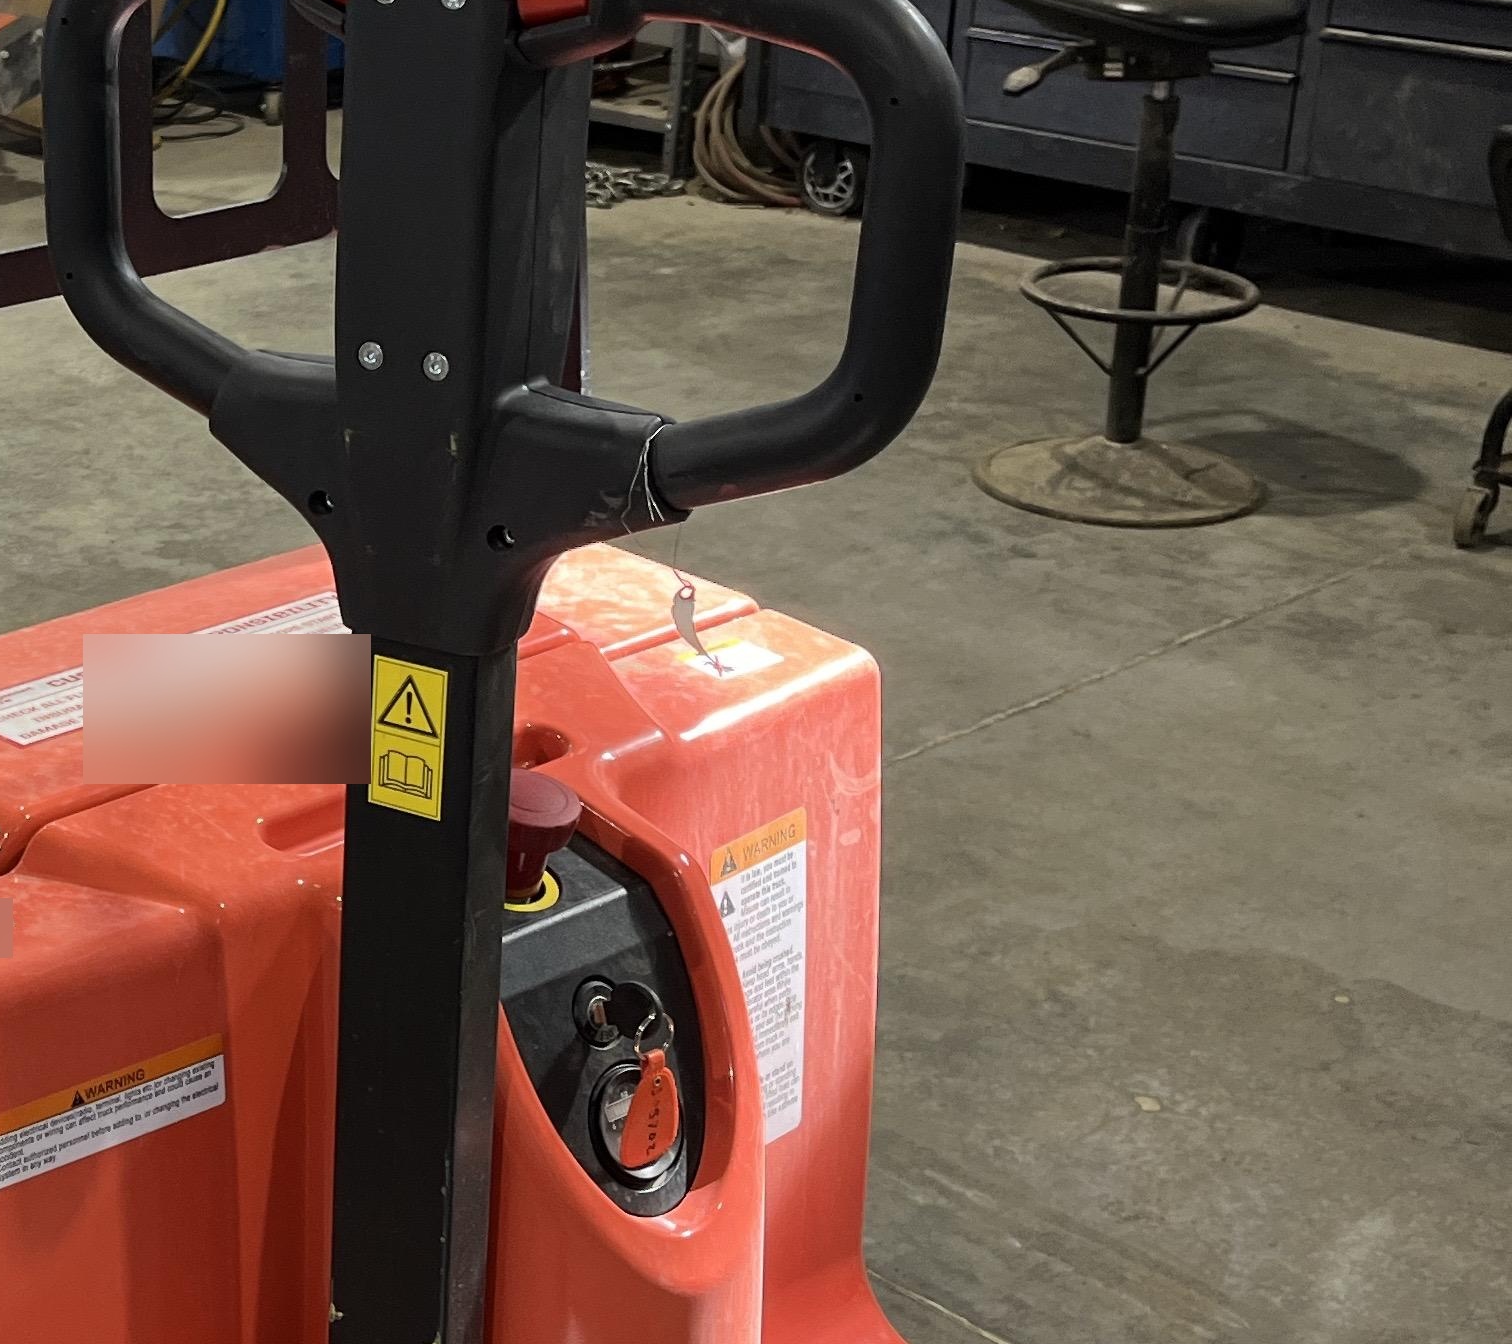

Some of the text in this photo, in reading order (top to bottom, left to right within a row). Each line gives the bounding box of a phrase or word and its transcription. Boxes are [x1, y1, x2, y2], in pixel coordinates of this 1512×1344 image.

[742, 824, 795, 862] WARNING
[85, 1068, 144, 1099] WARNING
[19, 1121, 48, 1139] electrical
[23, 1144, 57, 1164] authorized
[58, 1132, 89, 1151] personnel
[91, 1124, 111, 1139] before
[112, 1116, 133, 1131] adding
[152, 1100, 179, 1117] changing
[192, 1085, 218, 1102] electrical
[44, 1124, 63, 1138] wiring
[65, 1119, 77, 1131] can
[114, 1092, 152, 1113] performance
[154, 1088, 165, 1099] and
